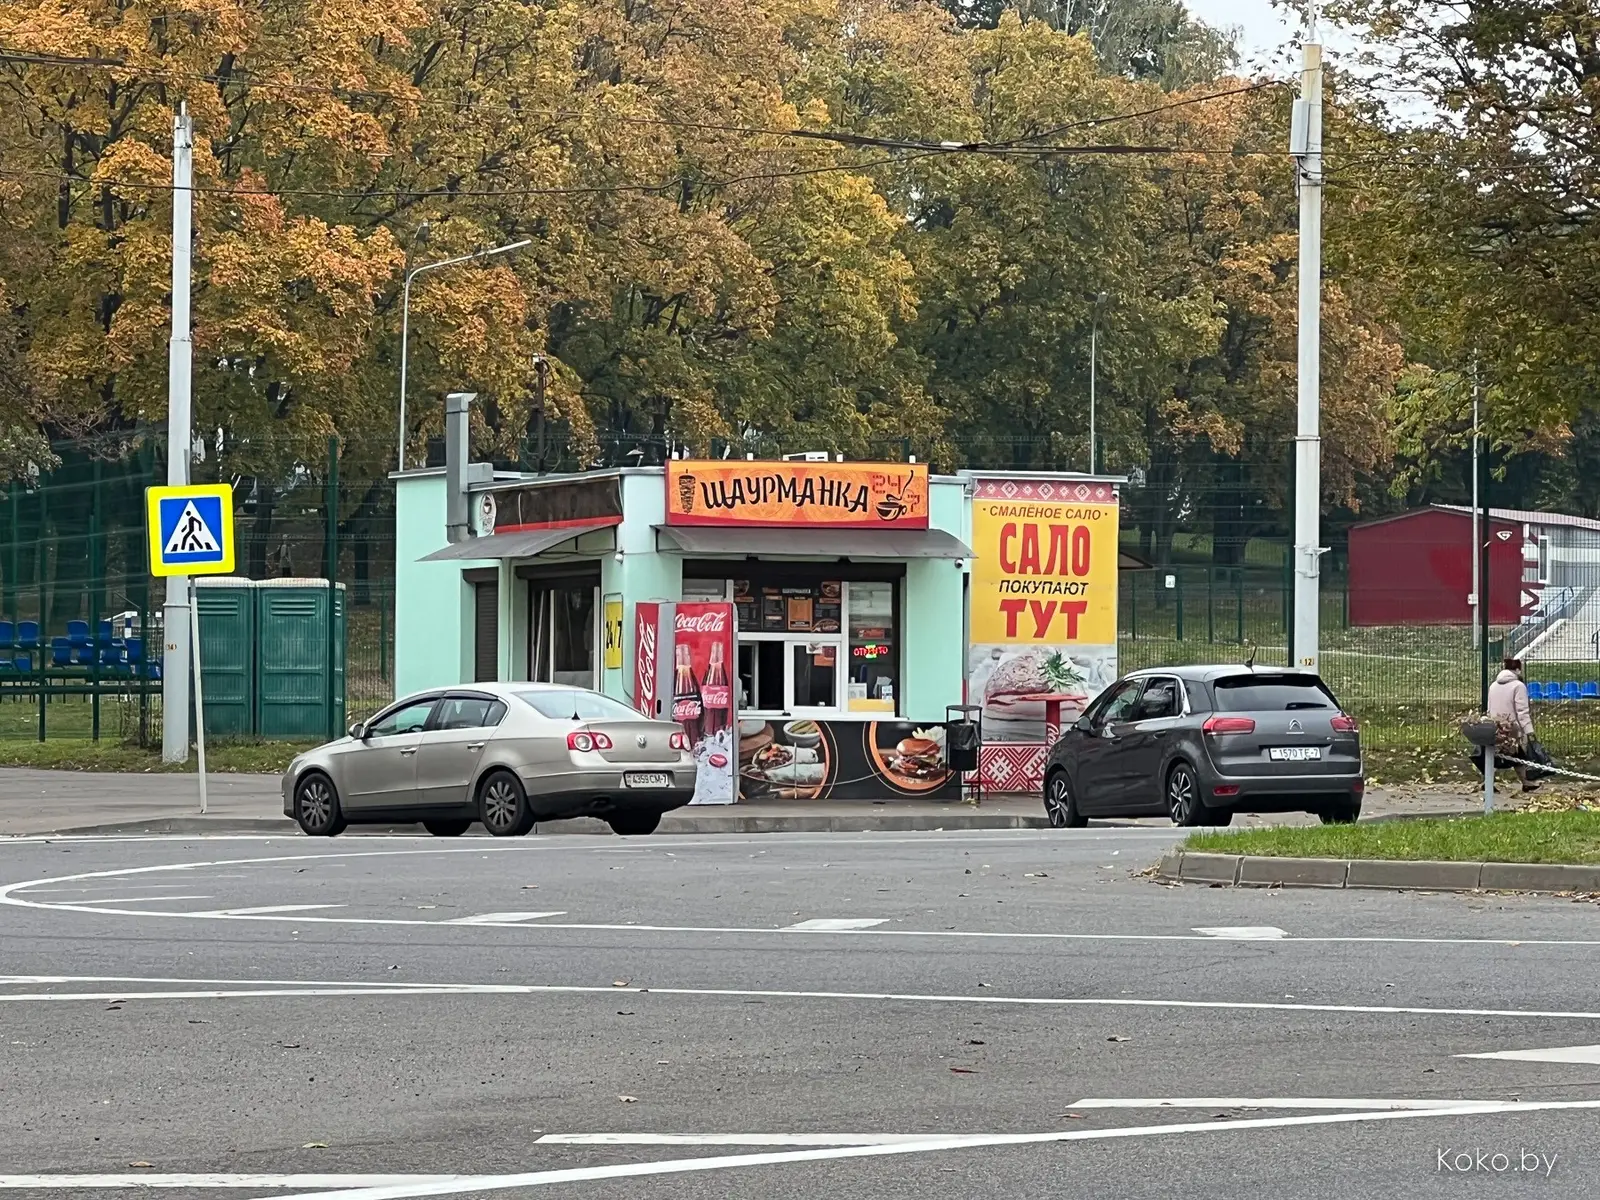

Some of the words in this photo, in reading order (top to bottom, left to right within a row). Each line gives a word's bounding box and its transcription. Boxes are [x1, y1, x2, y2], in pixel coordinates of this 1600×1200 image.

[701, 473, 868, 512] ШАУРМАНКА
[989, 504, 1062, 518] СМАЛЁНОЕ
[1065, 508, 1101, 520] САЛО
[999, 522, 1091, 576] САЛО
[998, 580, 1089, 595] ПОКУПАЮТ
[998, 598, 1088, 639] ТУТ
